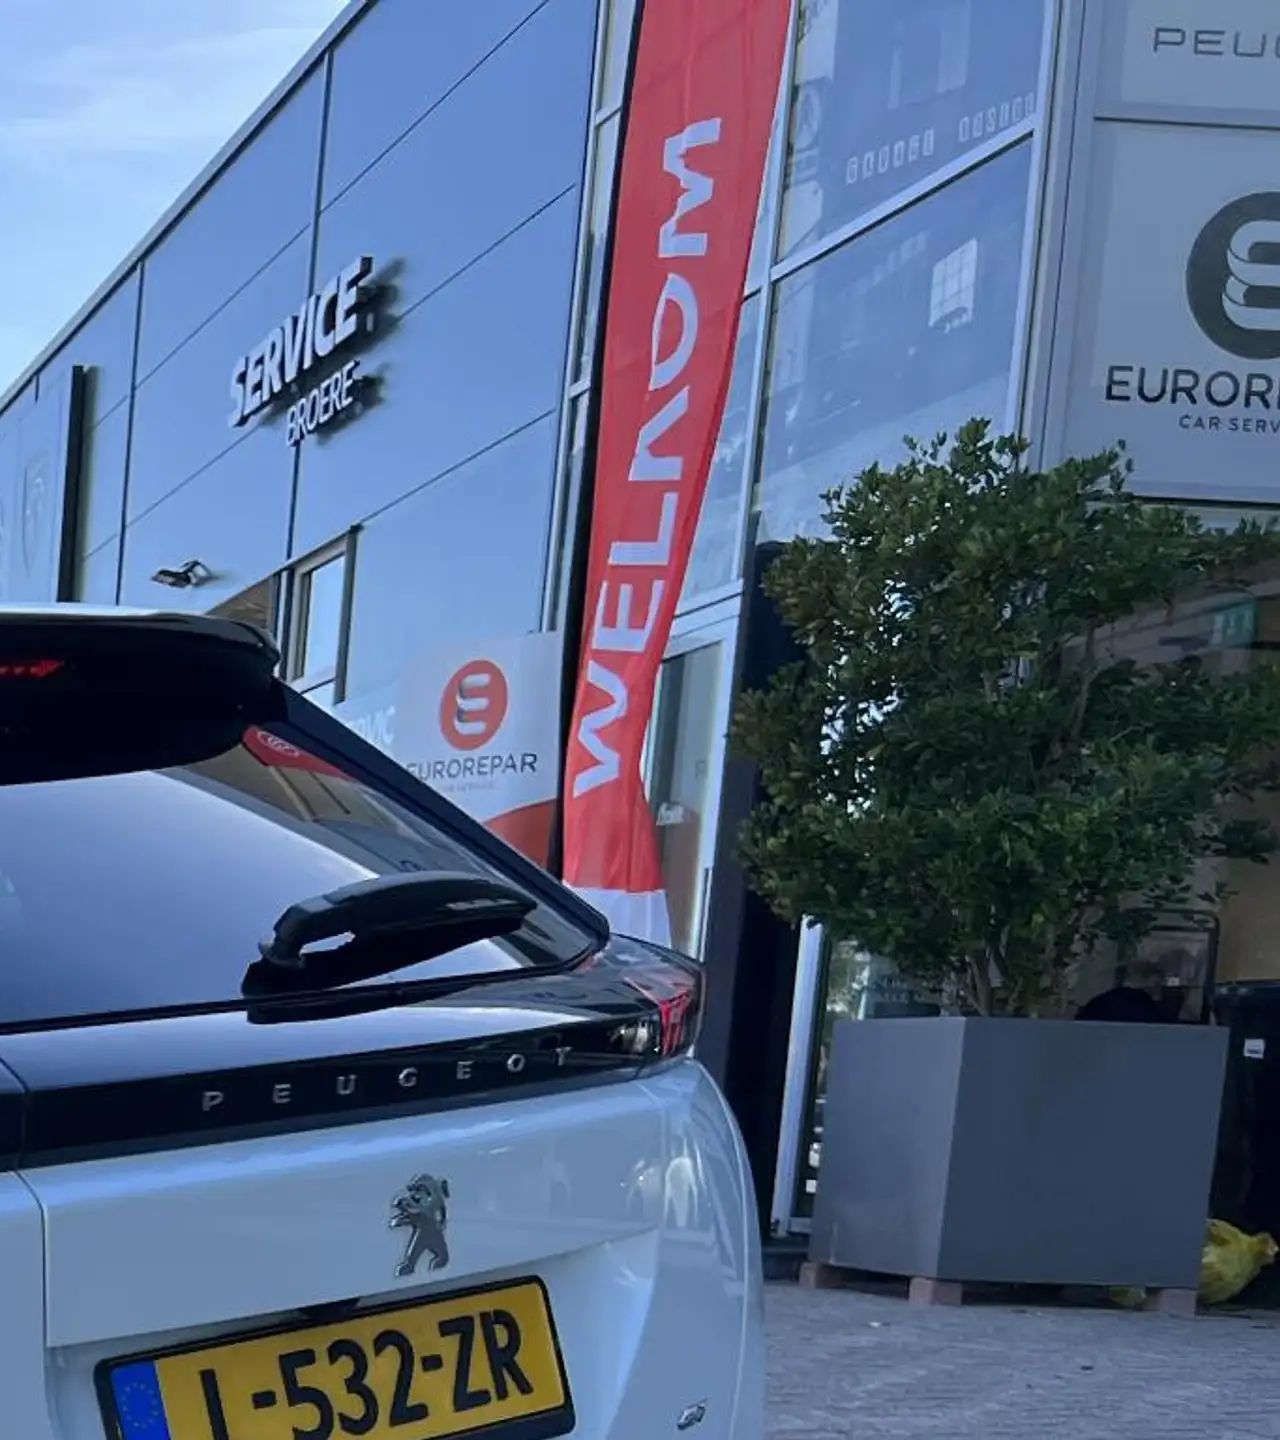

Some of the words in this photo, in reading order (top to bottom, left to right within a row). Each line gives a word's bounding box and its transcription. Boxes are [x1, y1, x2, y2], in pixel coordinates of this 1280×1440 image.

[1153, 27, 1280, 58] PEU
[228, 256, 375, 428] SERVICE
[285, 359, 361, 447] BROERE
[1105, 364, 1280, 410] EUROR
[1178, 414, 1220, 431] CAR
[202, 1046, 572, 1111] PEUGEOT
